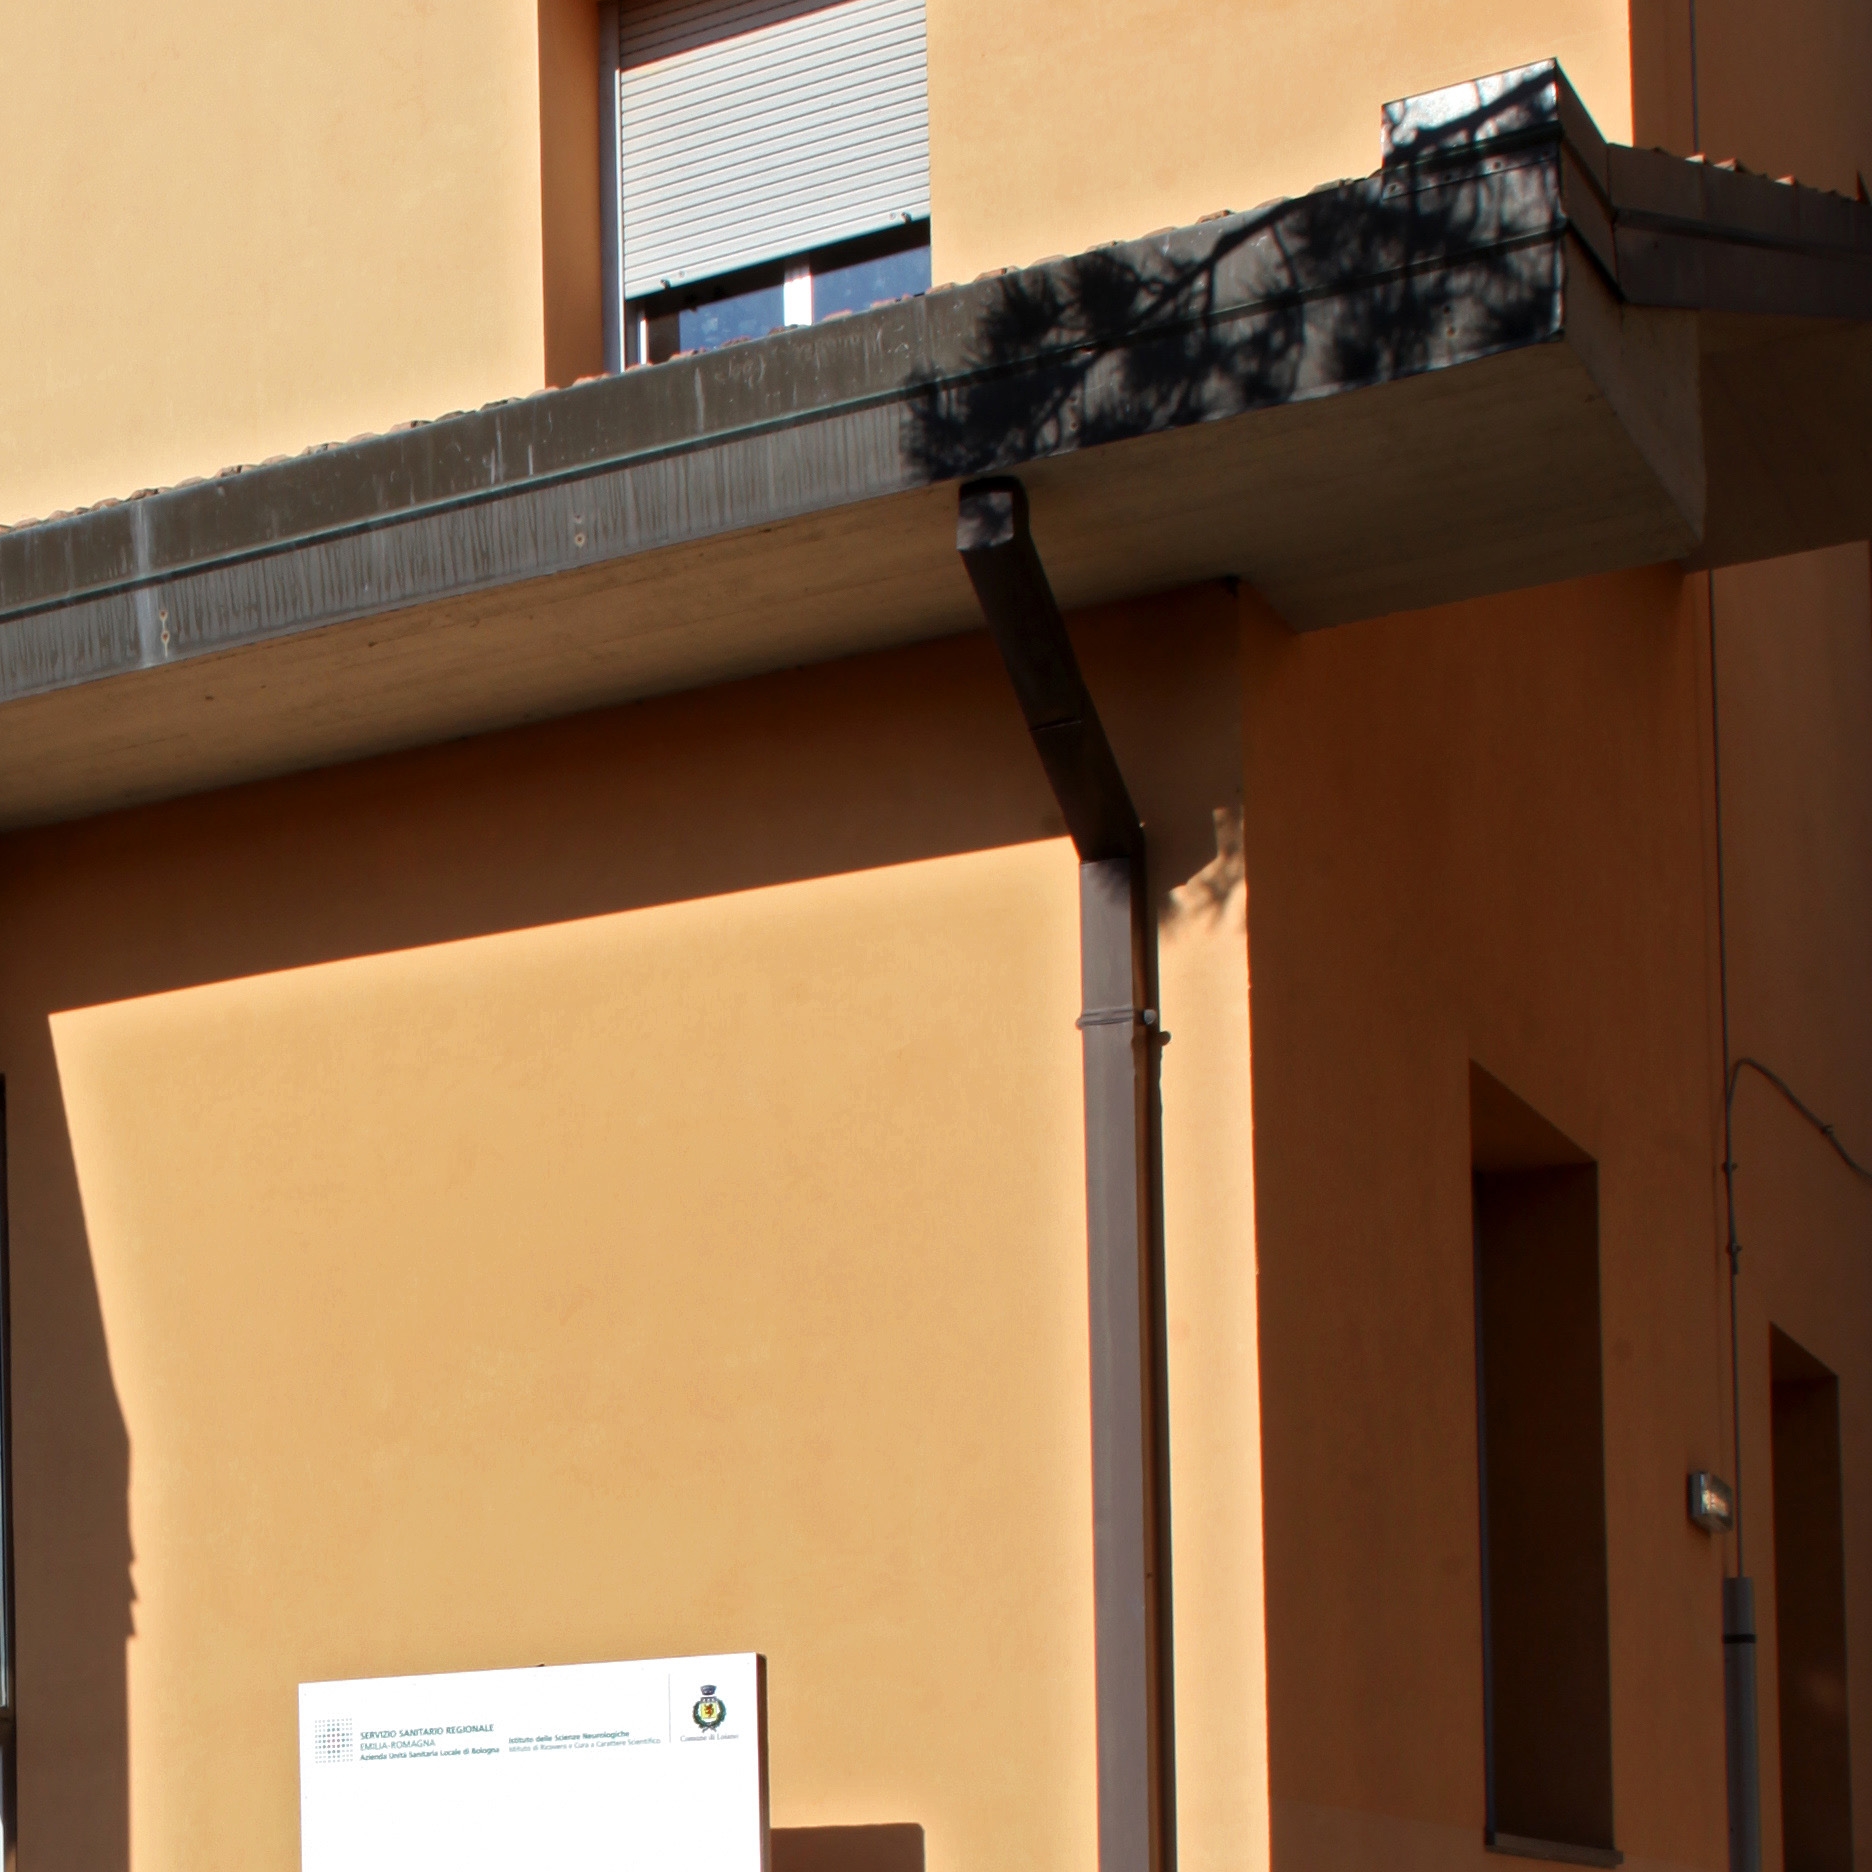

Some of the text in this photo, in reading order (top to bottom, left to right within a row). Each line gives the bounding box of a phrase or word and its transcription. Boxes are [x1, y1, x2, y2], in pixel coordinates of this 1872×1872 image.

[360, 1724, 494, 1739] SERVIZIO SANITARIO REGIONALE
